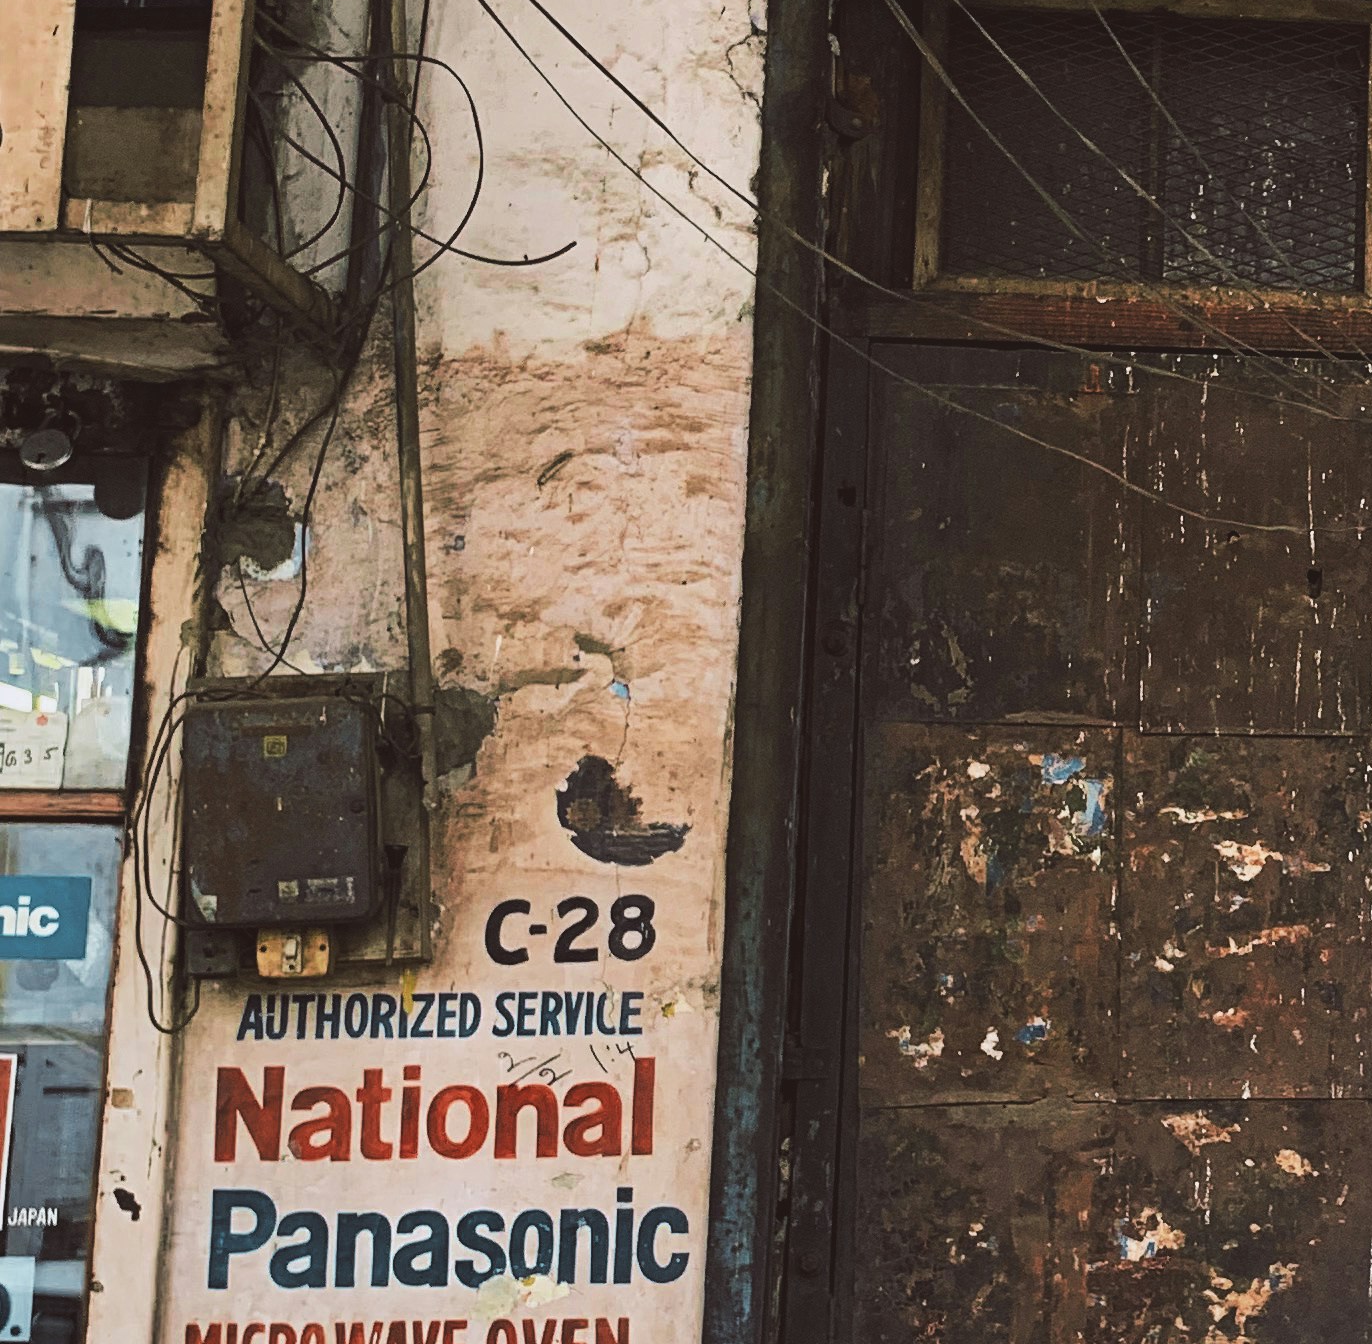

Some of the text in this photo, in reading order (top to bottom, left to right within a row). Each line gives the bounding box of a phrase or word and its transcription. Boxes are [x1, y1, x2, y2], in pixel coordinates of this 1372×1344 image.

[484, 894, 657, 966] C-28
[236, 990, 645, 1041] AUTHORIZED SERVICE
[213, 1057, 656, 1163] National
[7, 1206, 58, 1227] JAPAN
[207, 1187, 690, 1290] Panasonic
